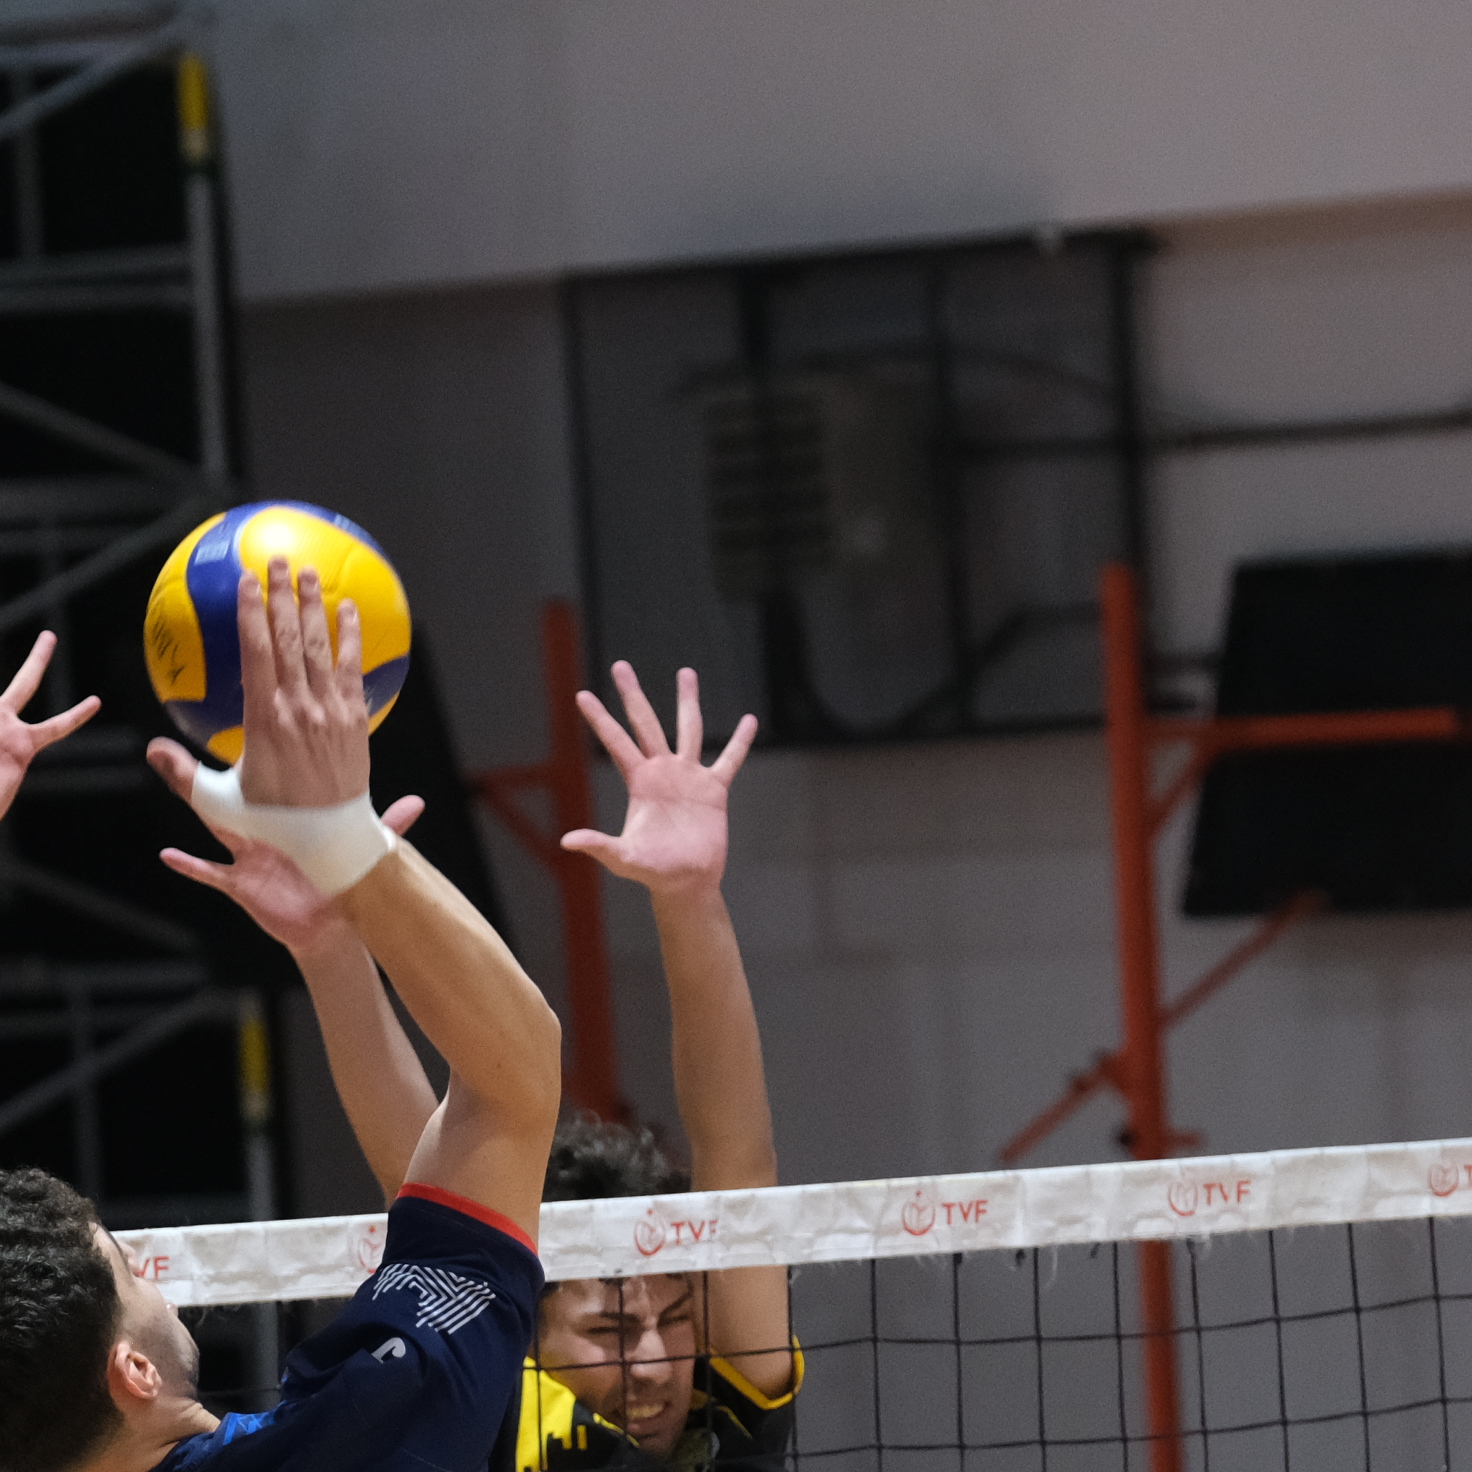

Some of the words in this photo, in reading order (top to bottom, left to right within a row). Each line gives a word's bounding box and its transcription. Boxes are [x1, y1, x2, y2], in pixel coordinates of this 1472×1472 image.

[1203, 1180, 1251, 1206] TVF
[942, 1199, 988, 1225] TVF
[671, 1218, 719, 1246] TVF
[134, 1256, 170, 1281] VF
